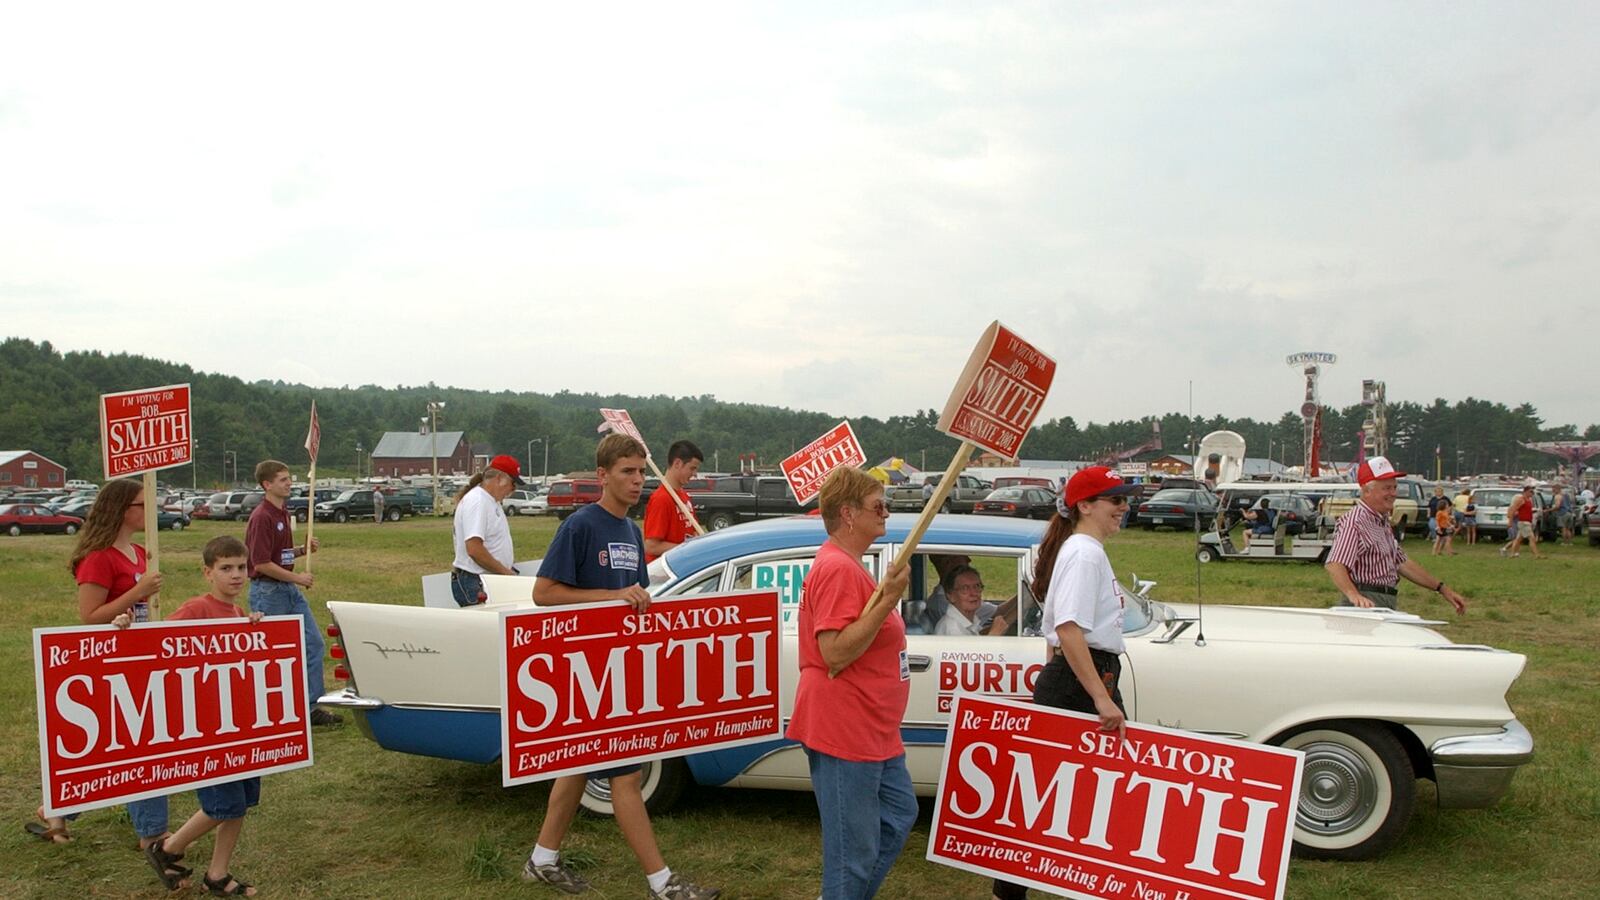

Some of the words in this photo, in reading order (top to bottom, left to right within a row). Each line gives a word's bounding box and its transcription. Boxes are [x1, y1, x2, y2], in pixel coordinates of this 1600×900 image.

[1008, 359, 1028, 380] BOB
[1288, 352, 1333, 363] SKYMASTER
[122, 397, 134, 407] I'M
[136, 393, 160, 405] VOTING
[162, 391, 175, 400] FOR
[141, 404, 159, 418] BOB
[967, 366, 1043, 430] SMITH
[110, 413, 188, 454] SMITH
[995, 430, 1017, 451] 2002
[113, 457, 131, 472] U.S.
[133, 450, 169, 467] SENATE
[170, 446, 187, 460] 2002
[791, 438, 857, 490] SMITH
[810, 446, 826, 459] BOB
[512, 614, 579, 648] Re-Elect
[622, 605, 741, 636] SENATOR
[49, 634, 118, 668] Re-Elect
[161, 631, 268, 659] SENATOR
[941, 651, 994, 662] RAYMOND
[999, 653, 1007, 663] S.
[516, 630, 773, 733] SMITH
[940, 661, 1045, 693] BURTO
[54, 656, 301, 760] SMITH
[662, 729, 679, 746] for
[684, 725, 709, 742] New
[714, 714, 774, 737] Hampshire
[961, 709, 1031, 731] Re-Elect
[1078, 731, 1236, 782] SENATOR
[202, 756, 219, 776] for
[223, 752, 246, 769] New
[251, 741, 303, 764] Hampshire
[949, 741, 1279, 886] SMITH
[1098, 873, 1126, 894] for
